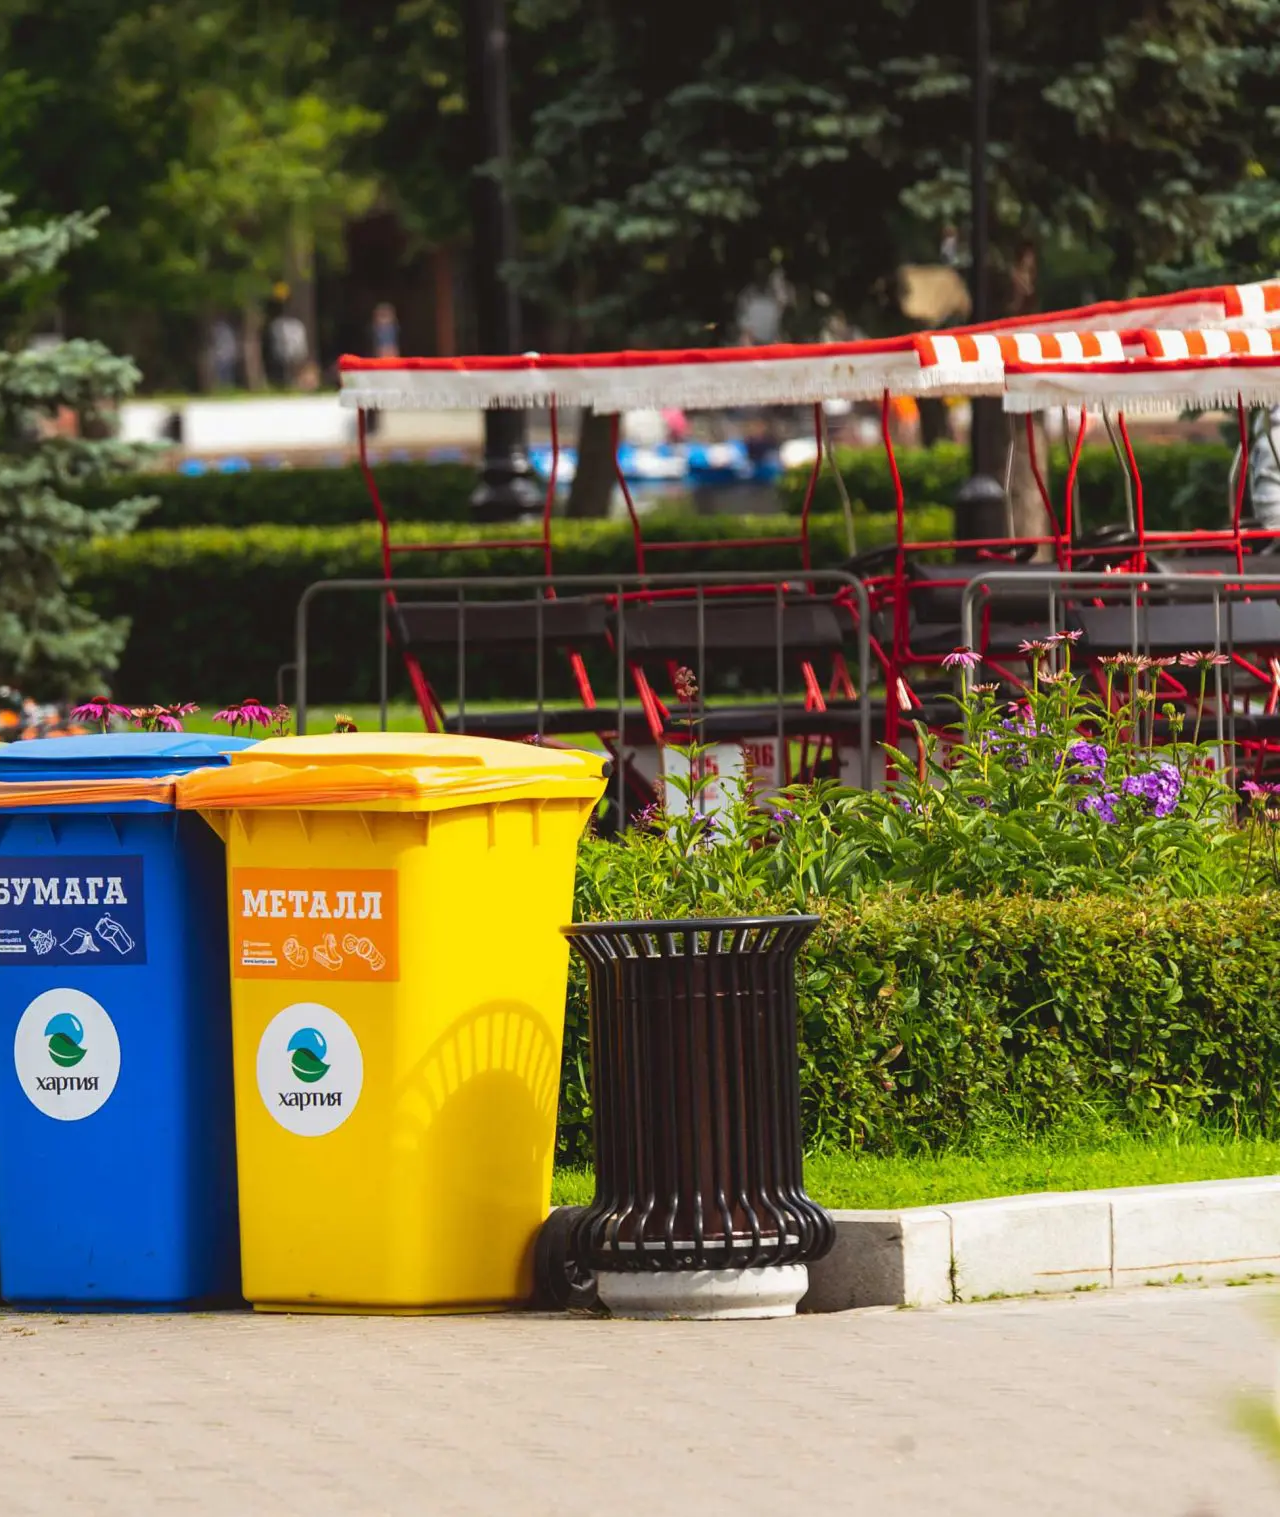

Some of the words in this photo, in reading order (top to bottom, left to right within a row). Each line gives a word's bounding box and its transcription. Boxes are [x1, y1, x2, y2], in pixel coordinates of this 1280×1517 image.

[242, 889, 383, 919] МЕТАЛЛ
[35, 1076, 100, 1095] хартия
[278, 1091, 343, 1111] хартия
